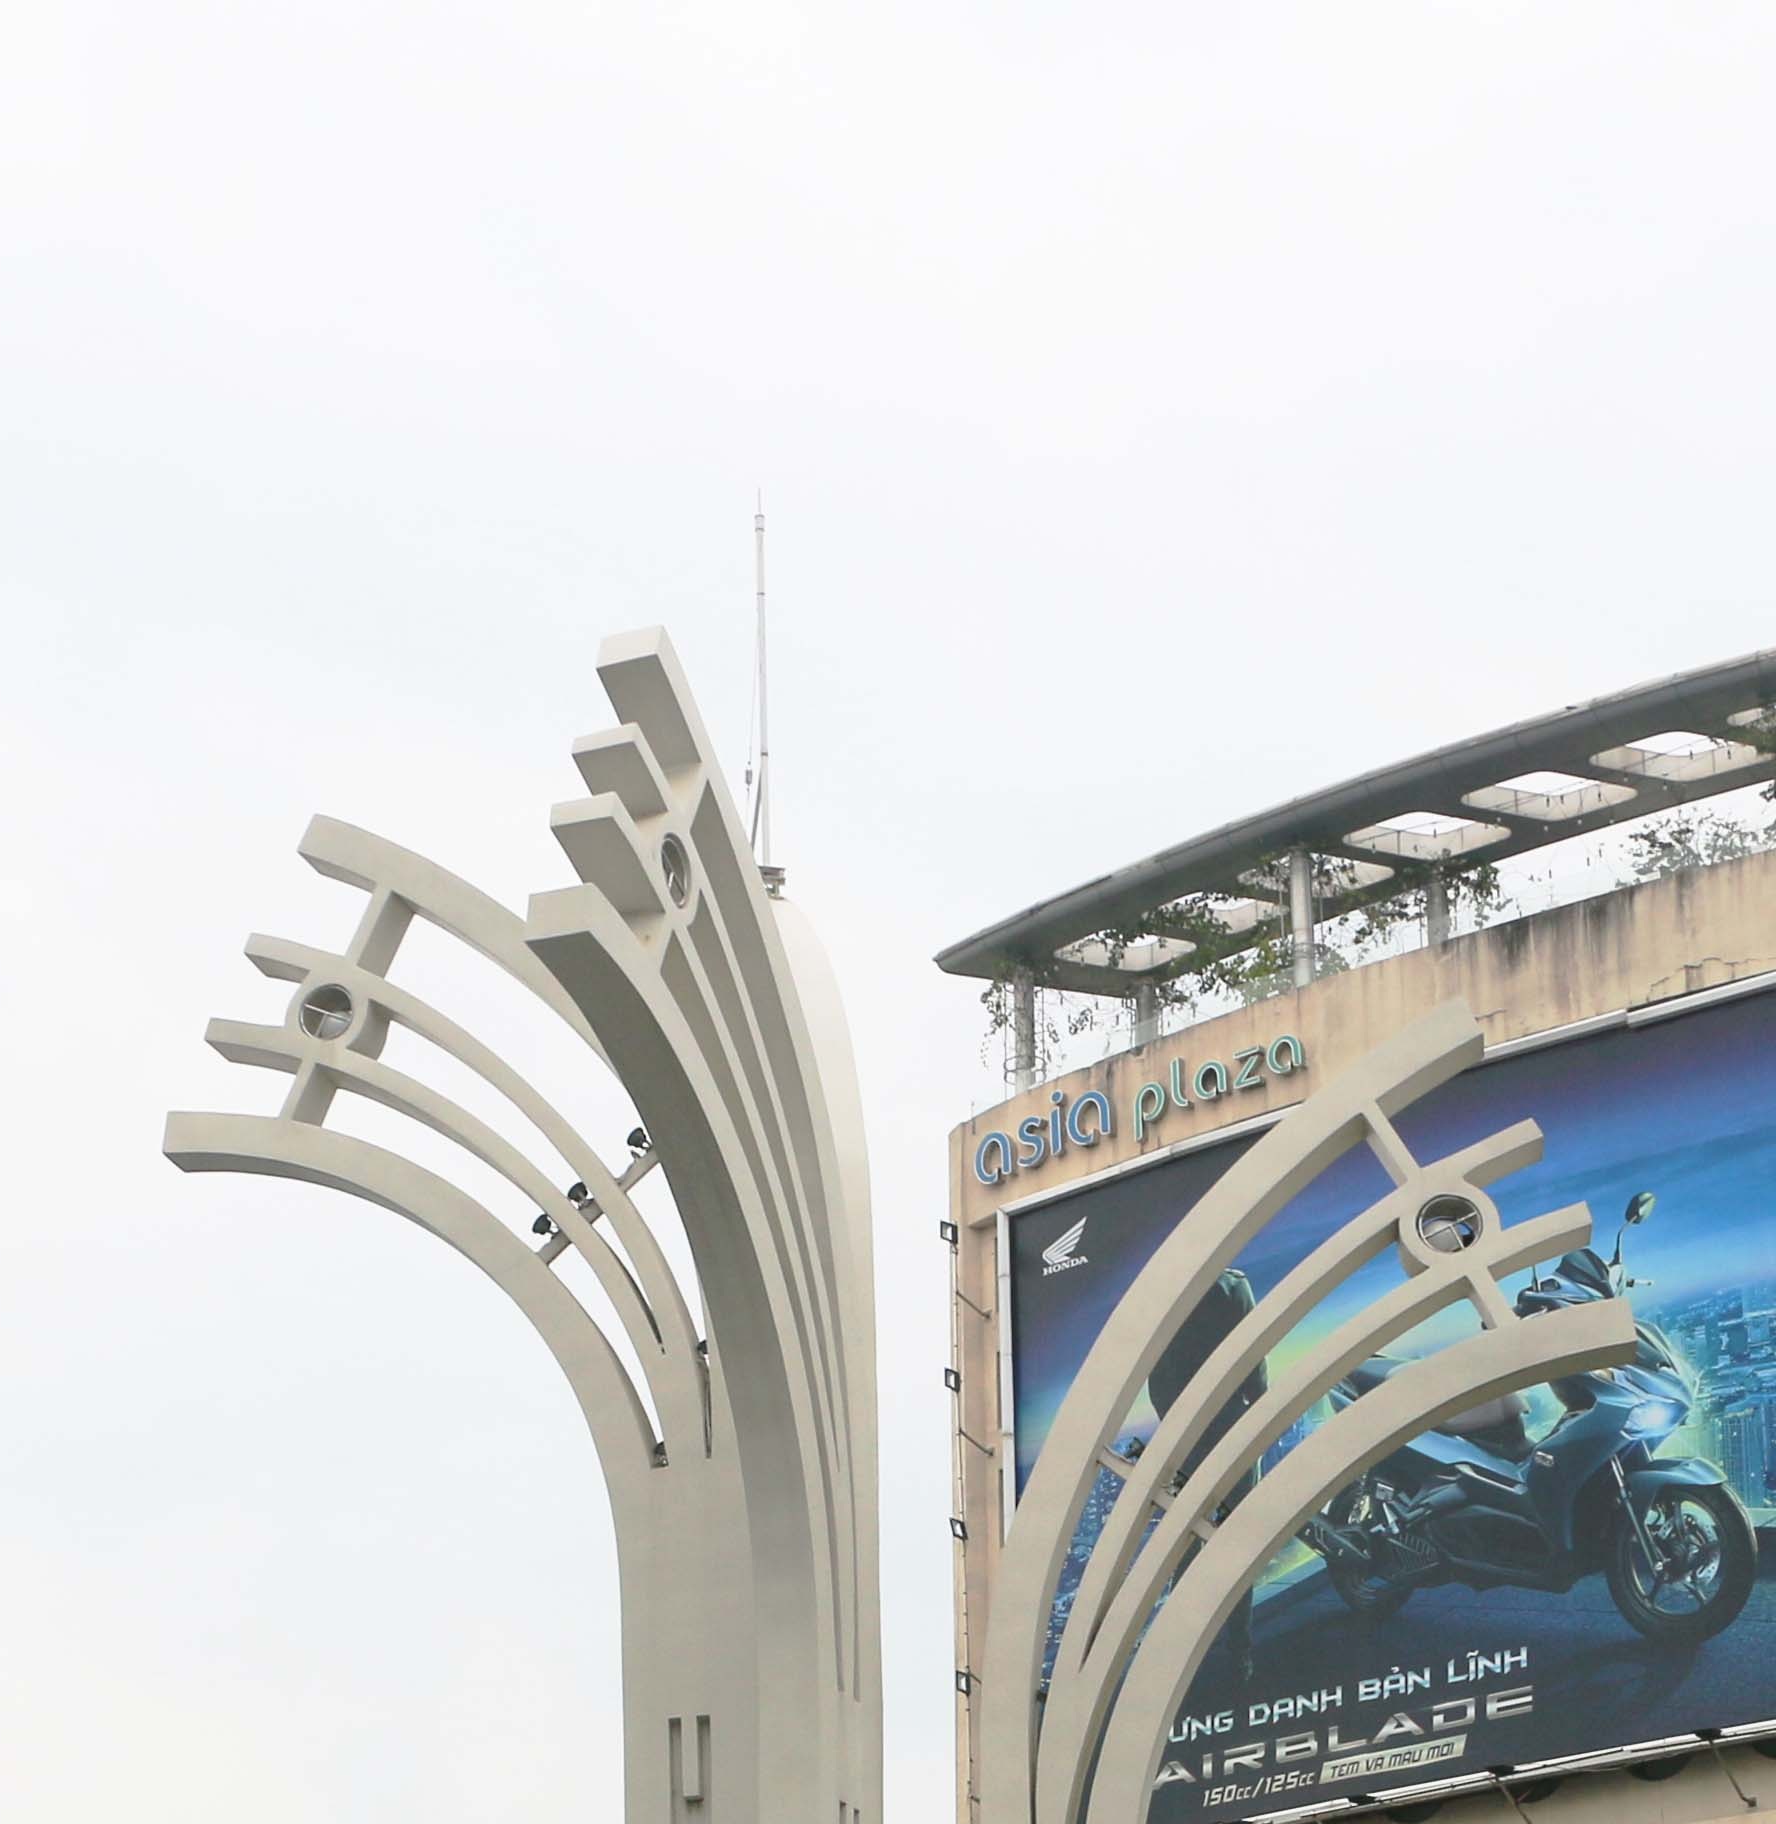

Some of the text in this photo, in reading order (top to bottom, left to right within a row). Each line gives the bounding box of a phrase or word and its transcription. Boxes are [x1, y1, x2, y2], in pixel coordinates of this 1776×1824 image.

[975, 1034, 1306, 1186] asia plaza
[1043, 1254, 1089, 1277] HONDA
[1248, 1646, 1529, 1727] DANH BẢN LĨNH
[1154, 1686, 1535, 1791] AIRBLADE
[1201, 1761, 1360, 1808] 150cc/125cc TEM
